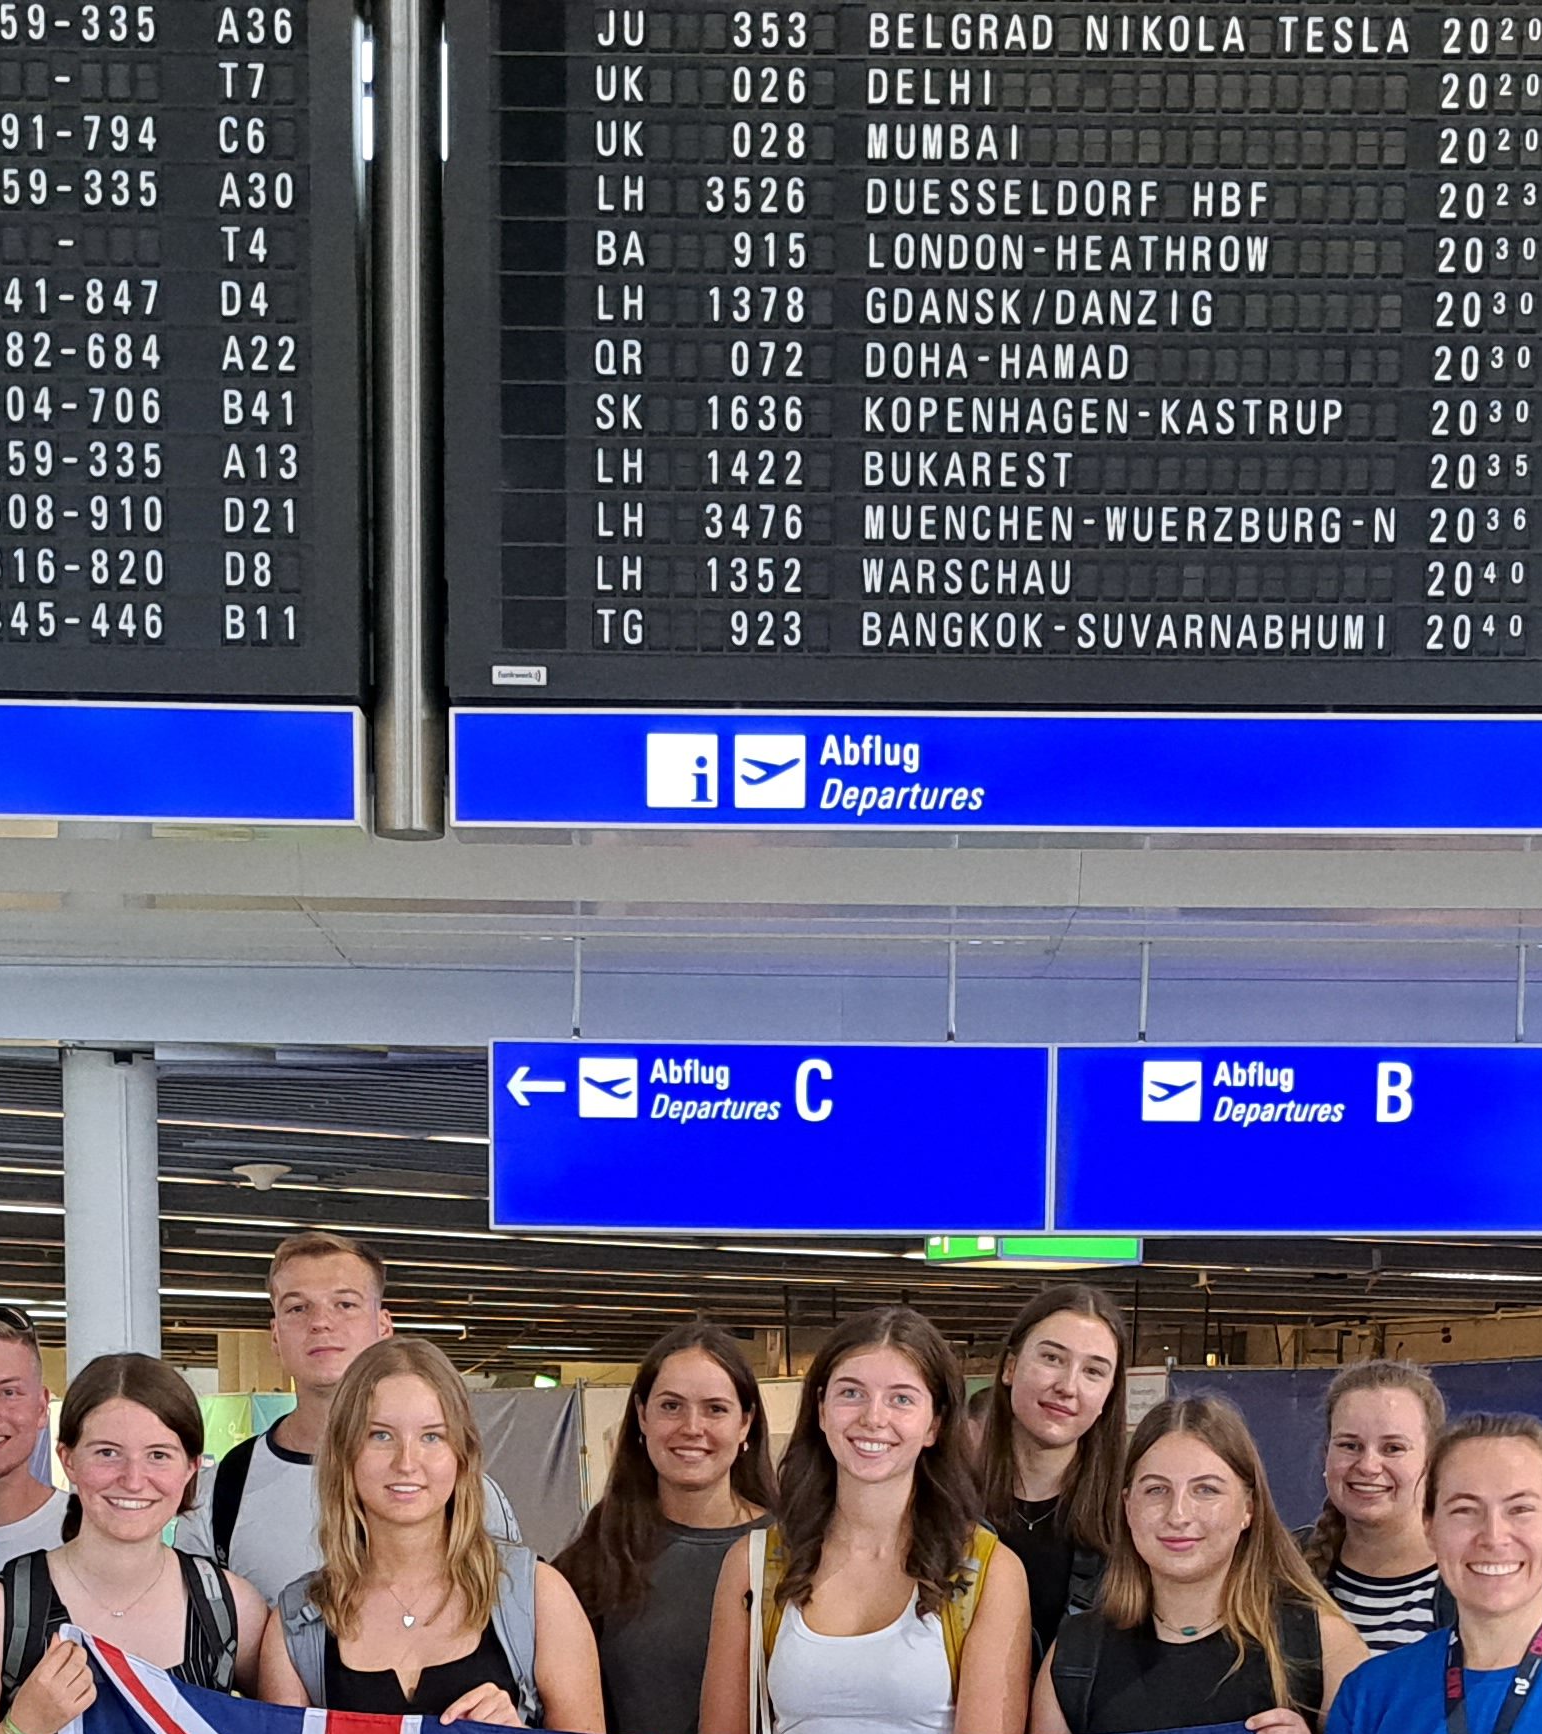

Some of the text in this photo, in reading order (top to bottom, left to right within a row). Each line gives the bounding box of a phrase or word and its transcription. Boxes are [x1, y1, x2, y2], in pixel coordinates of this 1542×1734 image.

[870, 13, 1408, 53] BELGRAD NIKOLA TESLA
[868, 69, 990, 105] DELHI
[868, 124, 1017, 160] MUMBAI
[867, 179, 1157, 216] DUESSELDORF
[1194, 182, 1267, 217] HBF
[867, 287, 1211, 326] GDANSK/DANZIG
[865, 451, 1072, 487] BUKAREST
[863, 559, 1070, 594] WARSCHAU
[820, 735, 919, 773] Abflug
[820, 779, 984, 815] Departures
[650, 1059, 832, 1121] Abflug C
[1214, 1061, 1412, 1122] Abflug B
[651, 1094, 780, 1124] Departures
[1214, 1097, 1344, 1127] Departures
